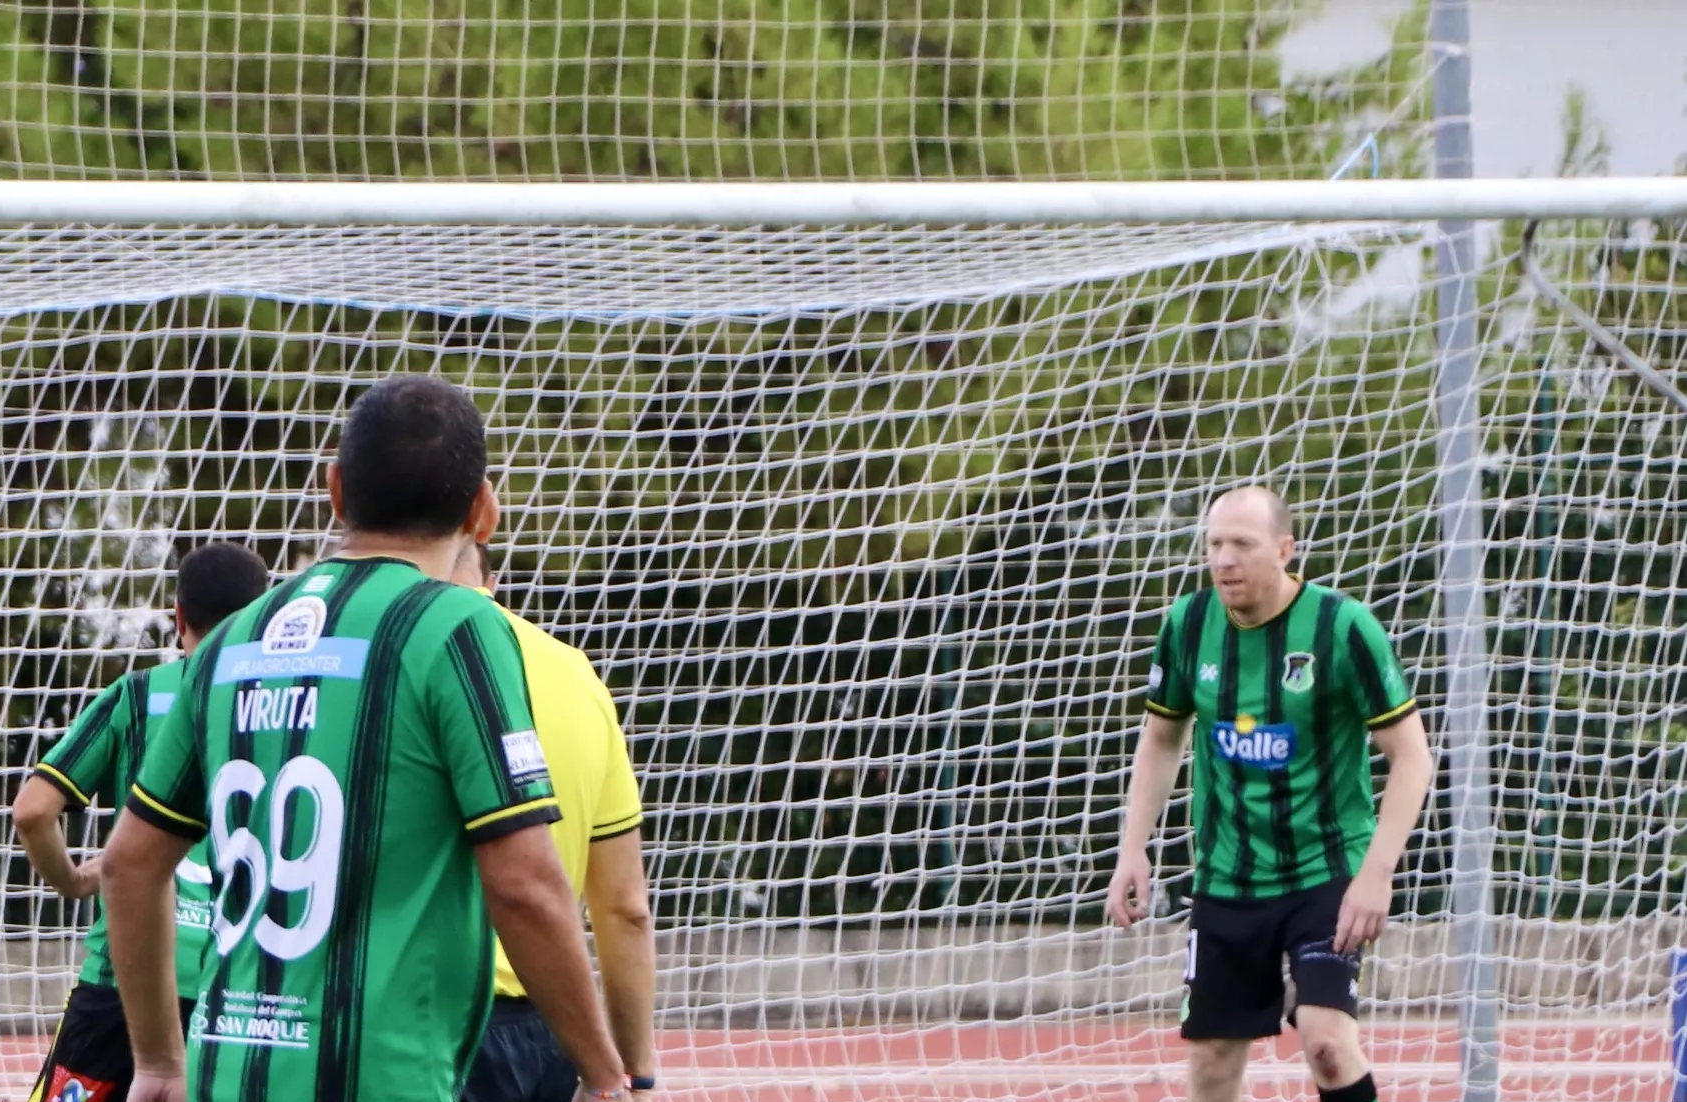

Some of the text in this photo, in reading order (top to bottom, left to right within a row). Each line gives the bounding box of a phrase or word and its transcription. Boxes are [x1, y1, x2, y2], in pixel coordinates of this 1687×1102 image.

[1217, 727, 1289, 762] Valle
[210, 754, 345, 961] 69
[216, 1015, 310, 1041] SAN ROQUE
